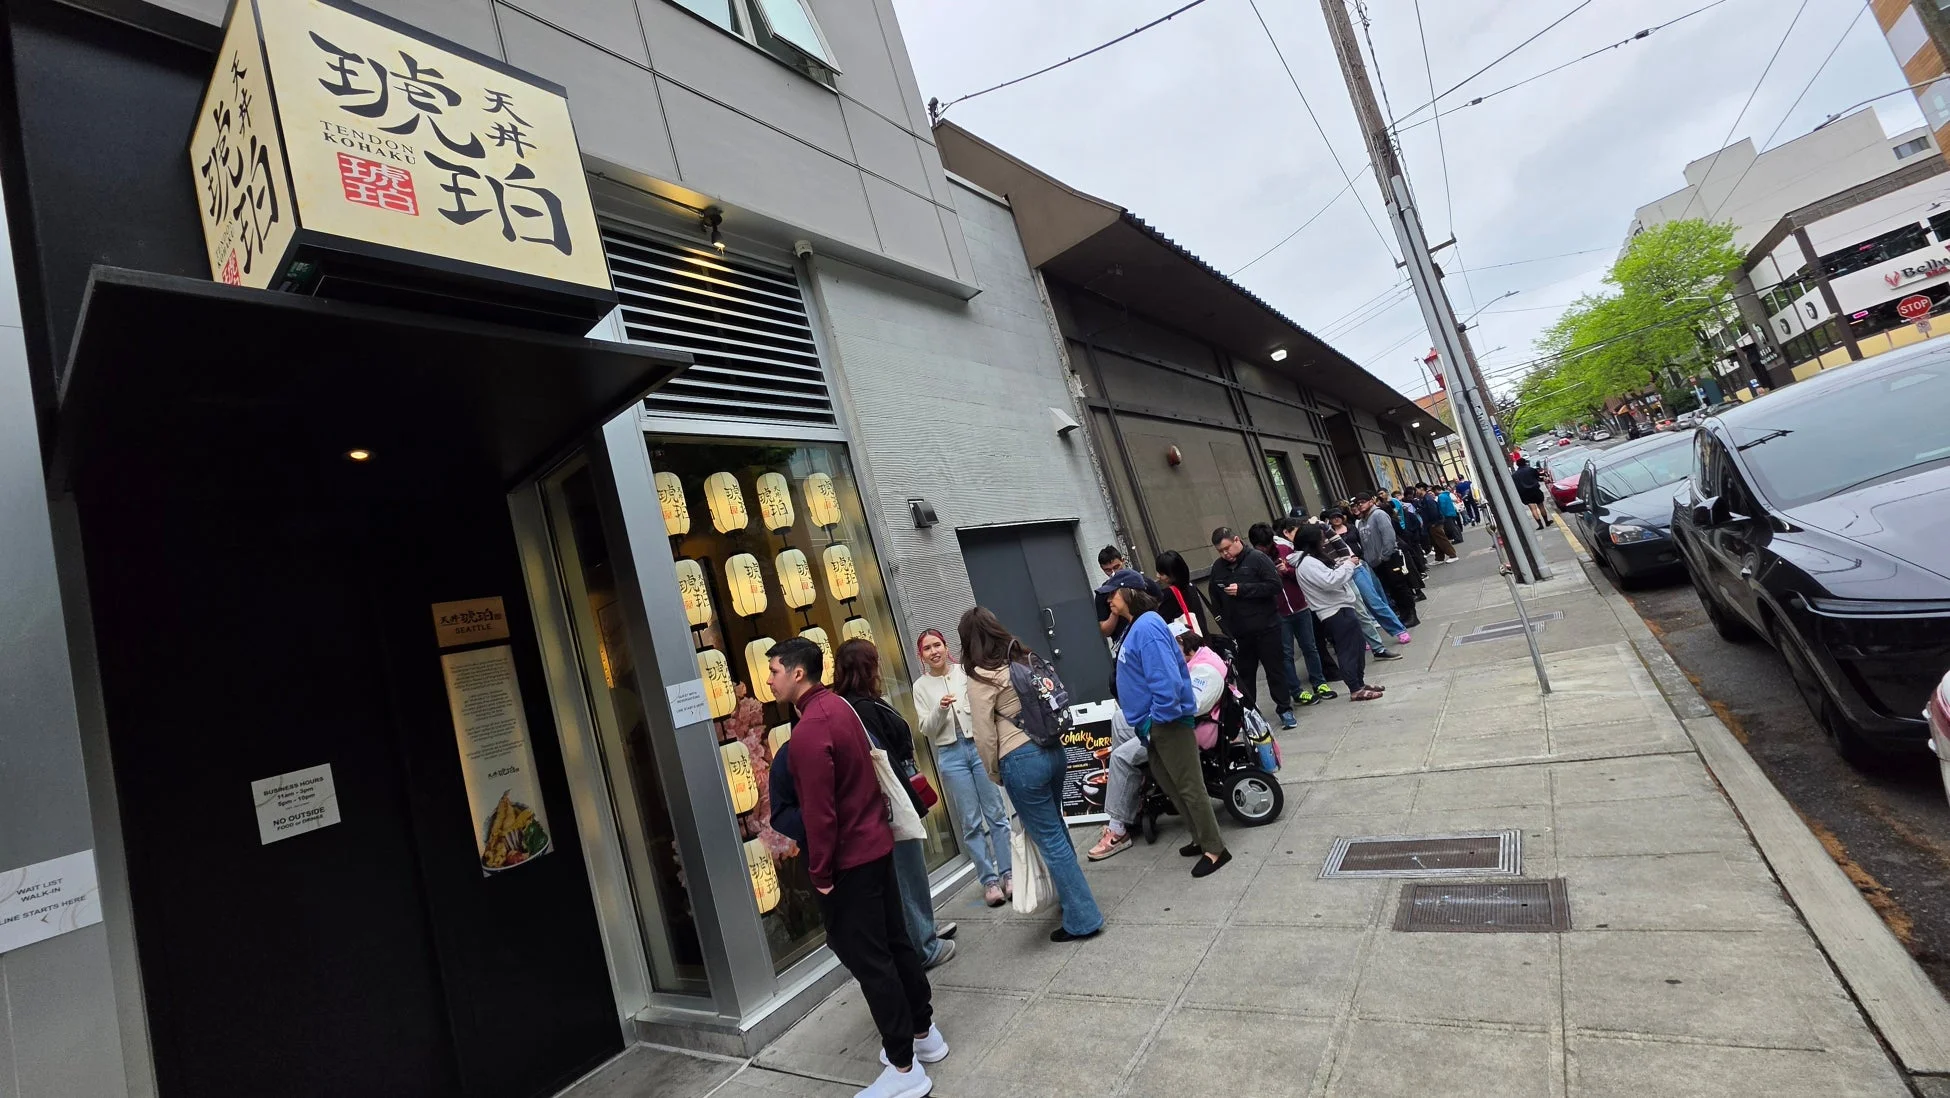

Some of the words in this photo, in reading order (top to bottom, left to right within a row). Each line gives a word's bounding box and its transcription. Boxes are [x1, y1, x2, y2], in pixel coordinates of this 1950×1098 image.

[484, 87, 538, 159] 天丼
[319, 120, 414, 154] TENDON
[323, 132, 416, 165] KOHAKU
[1900, 299, 1928, 314] STOP
[263, 782, 299, 797] BUSINESS
[300, 776, 324, 787] HOURS
[273, 817, 287, 827] NO
[288, 806, 326, 822] OUTSIDE
[276, 822, 294, 831] FOOD
[16, 884, 40, 895] WAIT
[42, 878, 63, 888] LIST
[20, 887, 61, 903] WALK-IN
[22, 903, 60, 919] STARTS
[61, 895, 86, 907] HERE
